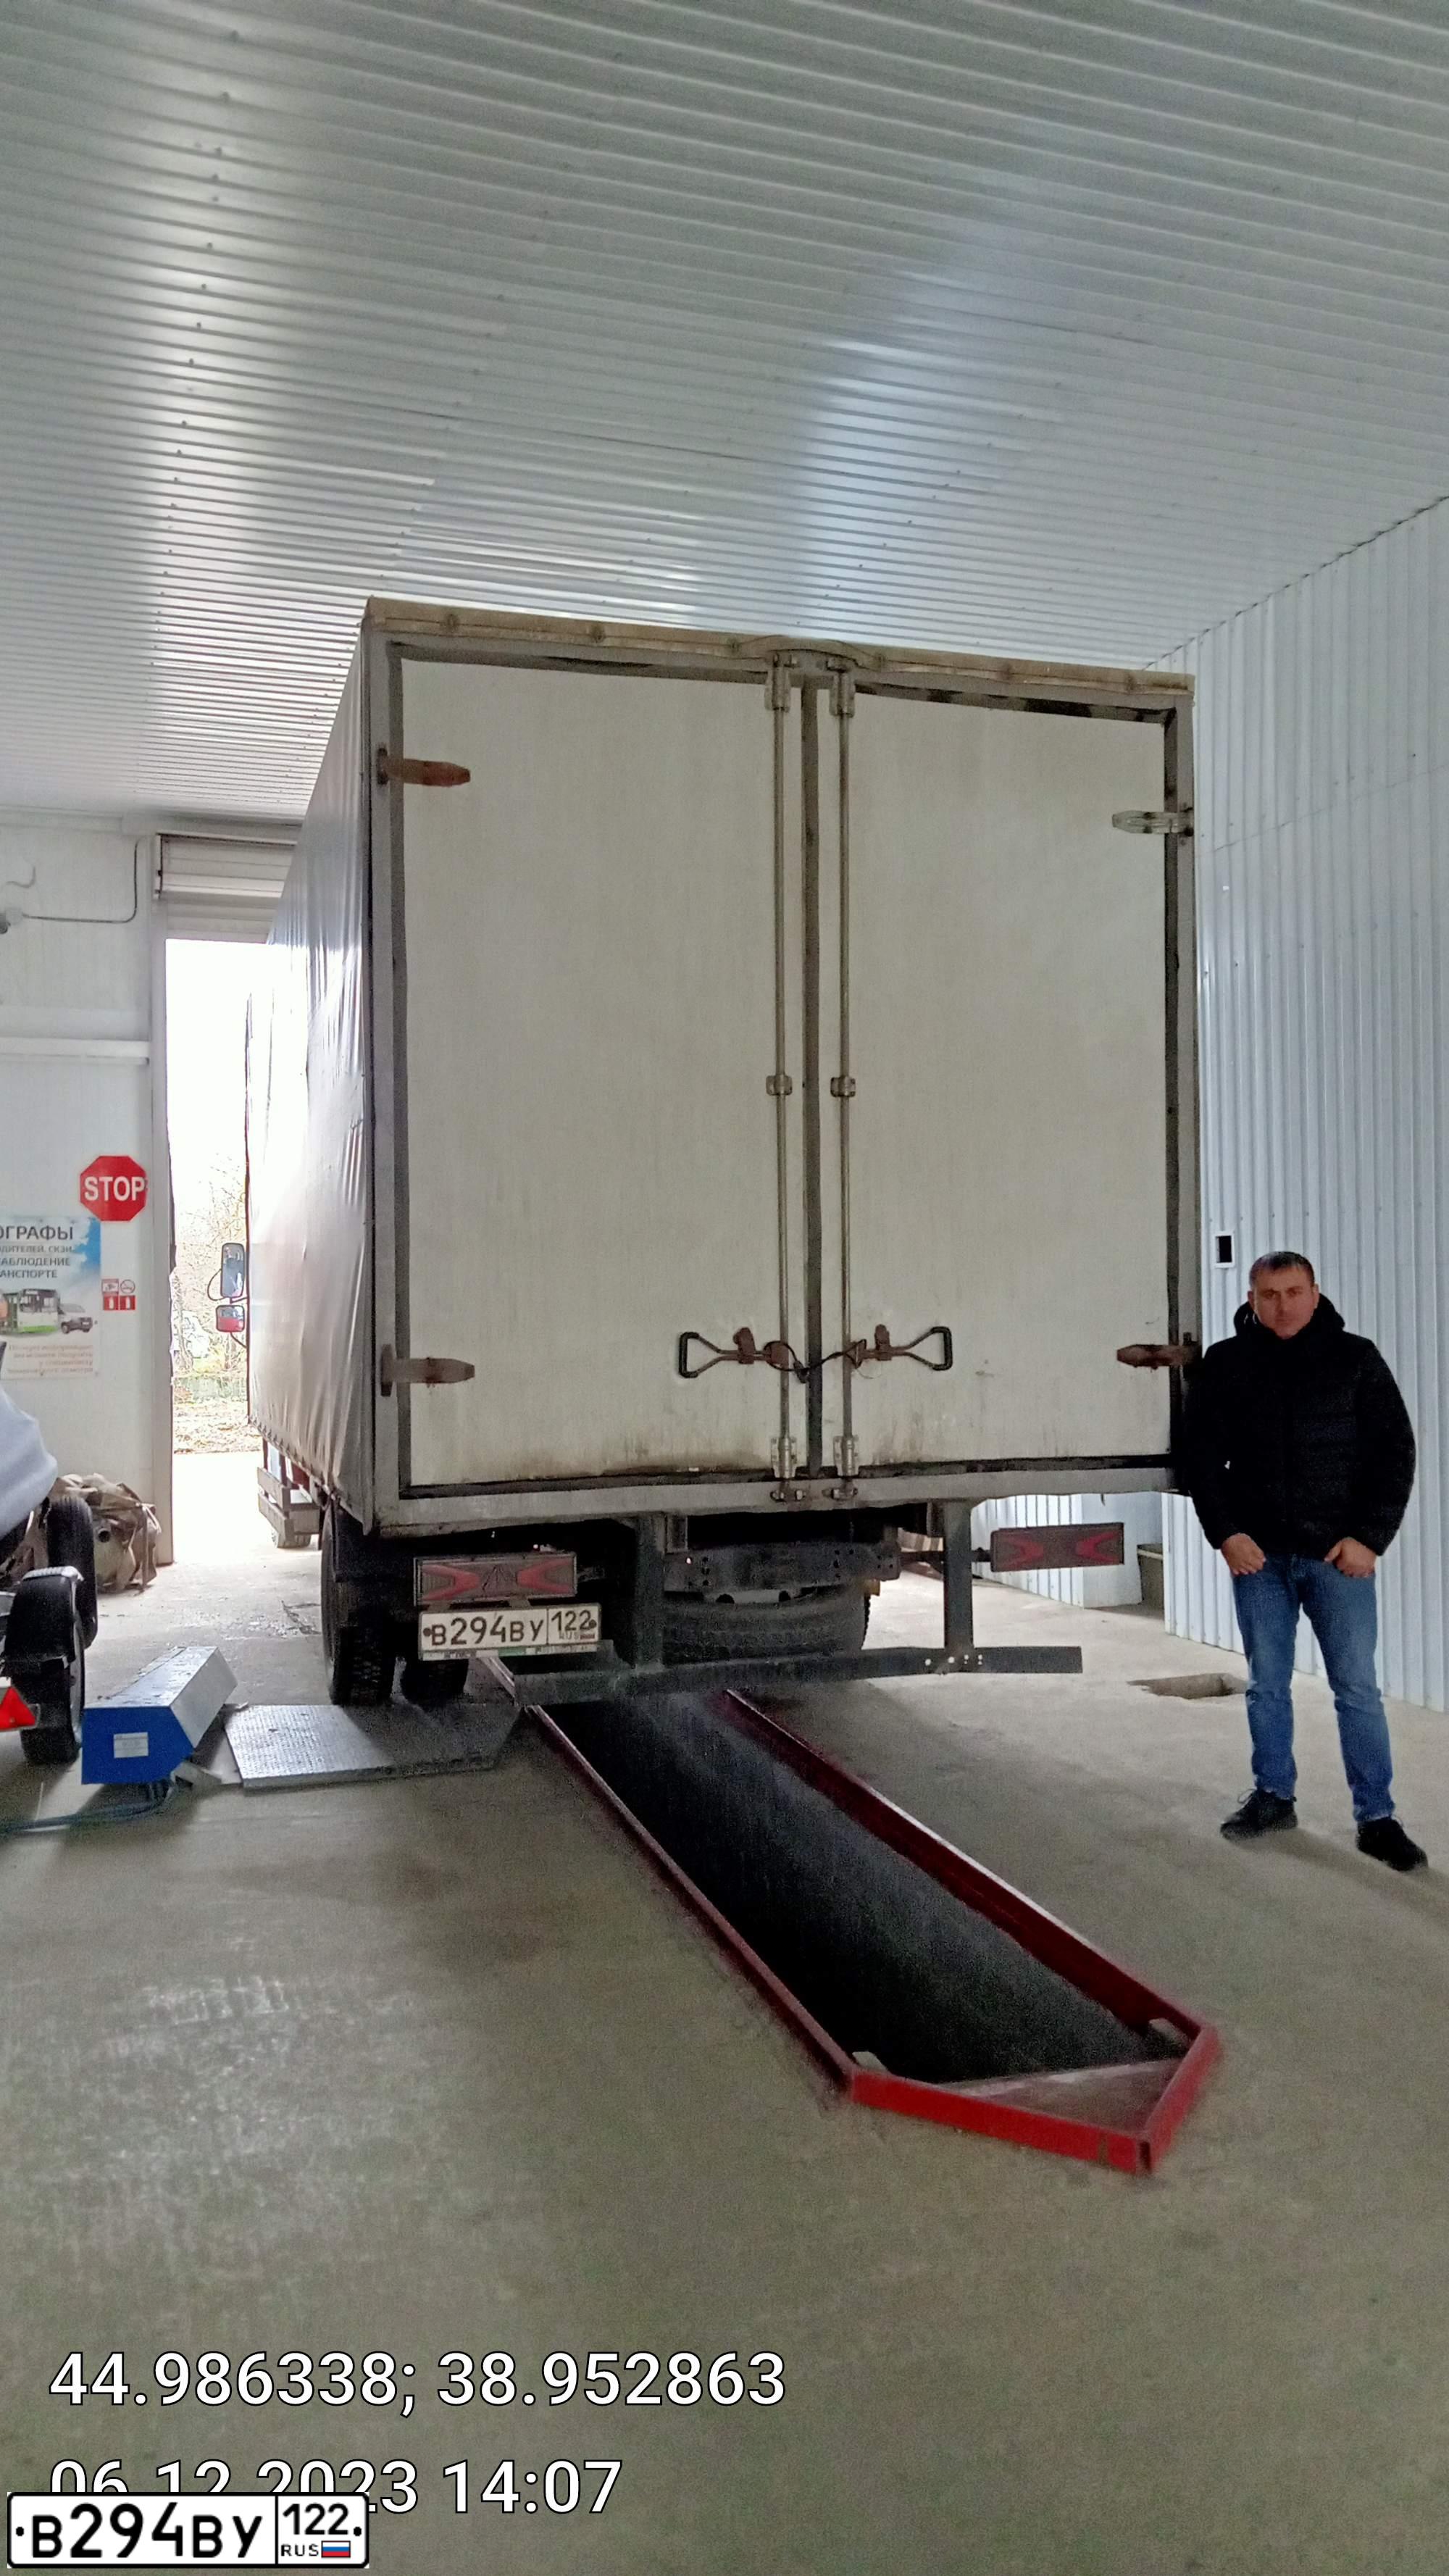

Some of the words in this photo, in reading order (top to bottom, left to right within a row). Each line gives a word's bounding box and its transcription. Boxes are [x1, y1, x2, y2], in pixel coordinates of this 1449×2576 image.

[84, 1175, 145, 1201] STOP
[0, 1257, 70, 1267] АБЛЮДЕНИЕ
[551, 1609, 591, 1631] 122
